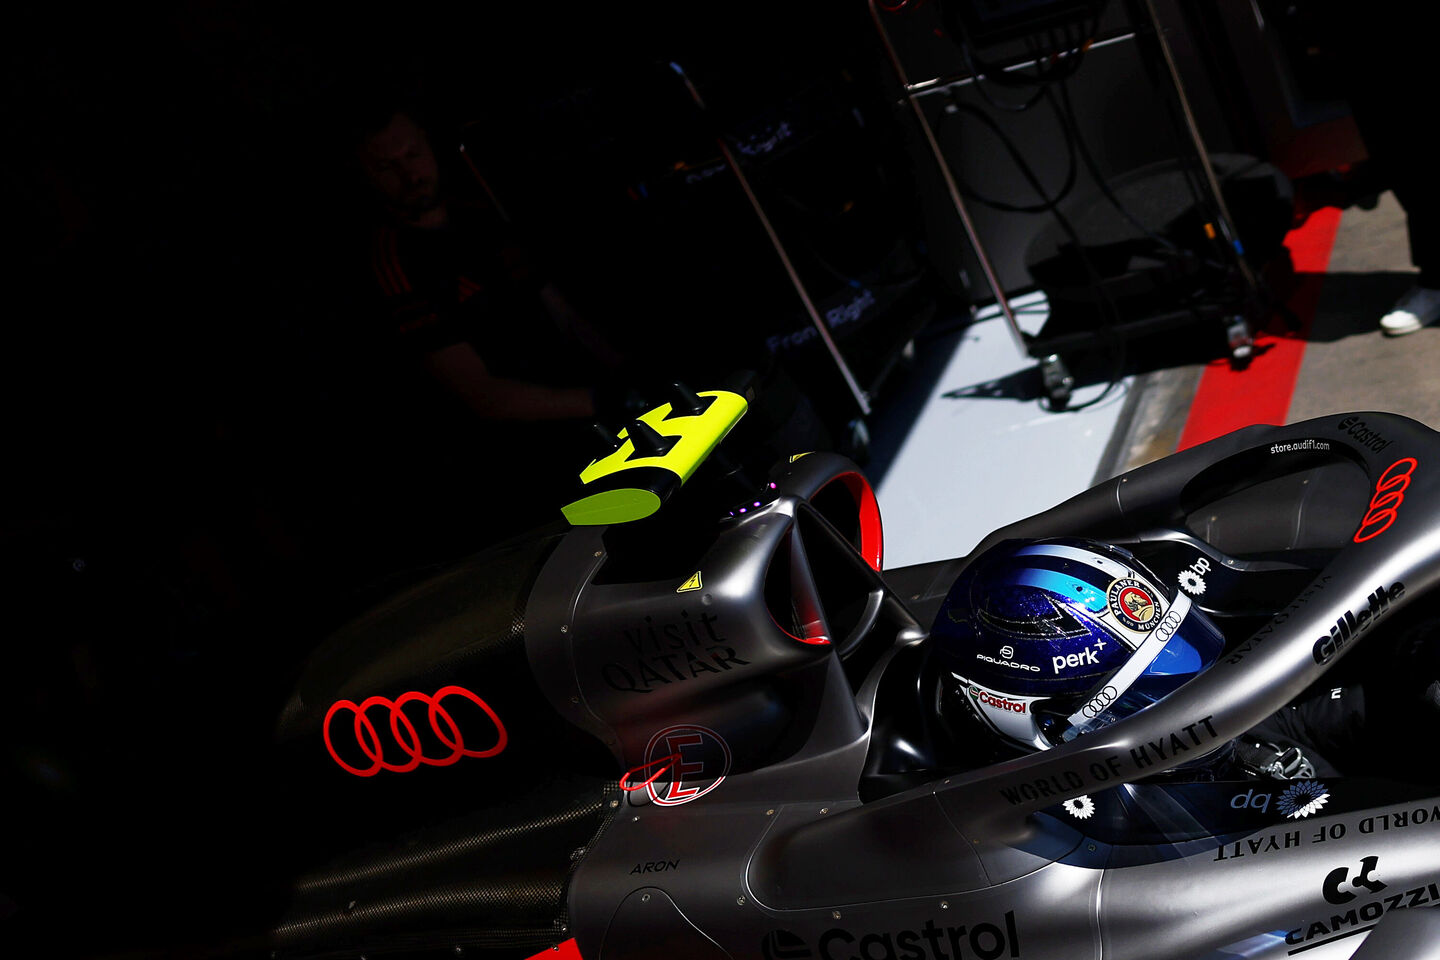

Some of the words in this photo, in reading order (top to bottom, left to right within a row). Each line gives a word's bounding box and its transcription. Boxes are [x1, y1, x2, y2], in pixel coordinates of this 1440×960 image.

[765, 325, 820, 354] Fron
[1270, 439, 1331, 455] store.audif1.com
[1347, 421, 1394, 455] Castrol
[1190, 556, 1211, 577] bp
[1110, 579, 1141, 617] PAULANER
[1312, 581, 1406, 666] Gillette
[601, 645, 752, 694] QATAR
[976, 653, 1041, 673] PIQUADRO
[979, 691, 1027, 714] Castrol
[999, 770, 1085, 806] WORLD
[1089, 755, 1122, 782] OF
[1129, 715, 1219, 769] HYATT
[1213, 830, 1301, 862] HYATT
[1312, 822, 1347, 844] OF
[629, 858, 681, 875] ARON
[1284, 883, 1440, 945] CAMOZZI
